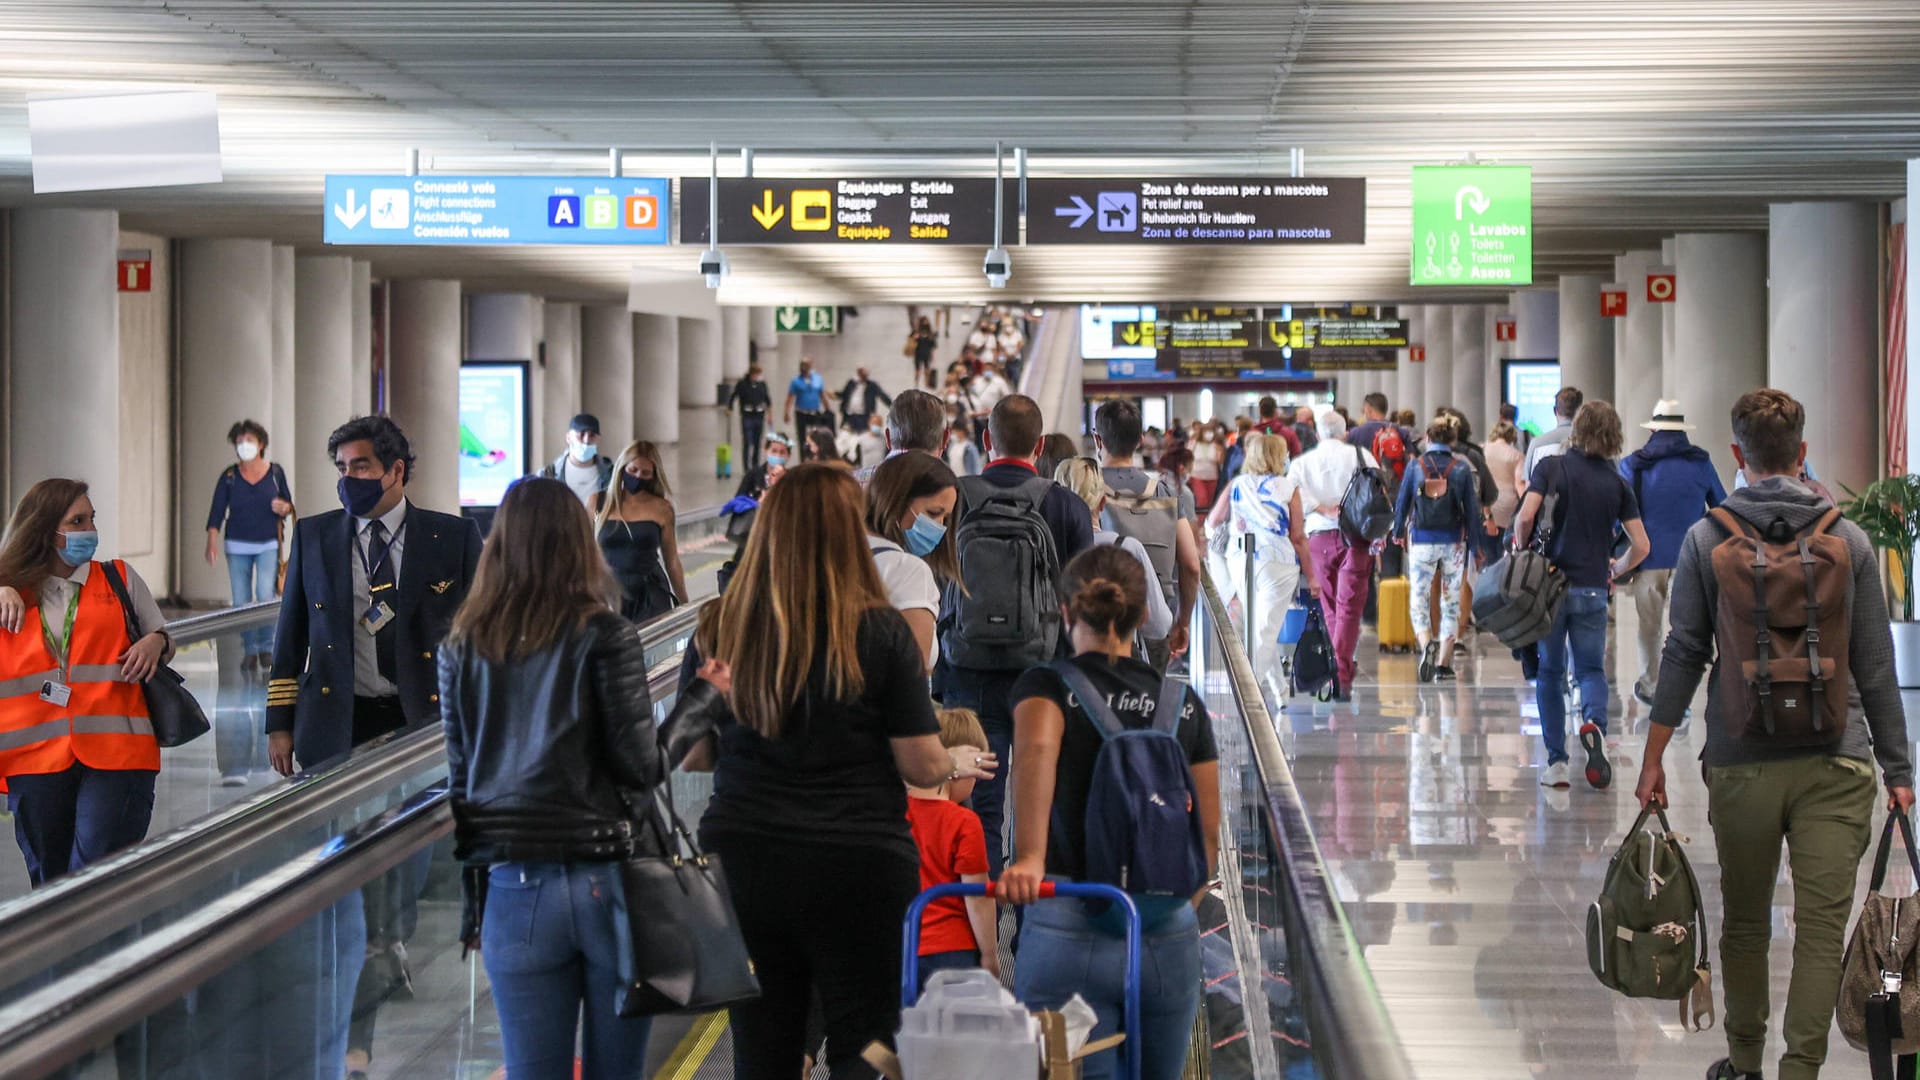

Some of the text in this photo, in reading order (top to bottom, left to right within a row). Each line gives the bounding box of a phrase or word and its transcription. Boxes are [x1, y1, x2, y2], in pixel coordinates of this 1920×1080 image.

[414, 181, 495, 194] Connexió vols
[837, 181, 904, 196] Equipatges
[910, 181, 954, 194] Sortida
[1142, 183, 1329, 198] Zona de descans per a mascotes
[414, 195, 496, 210] Flight connections
[837, 196, 877, 210] Baggage
[910, 197, 928, 209] Exit
[1142, 198, 1203, 210] Pet relief area
[414, 210, 483, 224] Anschlussflüge
[555, 199, 653, 225] A B D
[837, 210, 872, 224] Gepäck
[910, 211, 950, 225] Ausgang
[1142, 211, 1256, 224] Ruhebereich für Haustiere
[414, 225, 510, 238] Conexión vuelos
[837, 224, 891, 239] Equipaje
[910, 225, 948, 238] Salida
[1142, 226, 1332, 240] Zona de descanso para mascotas
[1469, 223, 1526, 236] Lavabos
[1471, 238, 1505, 250] Toilets
[1471, 252, 1515, 264] Toiletten
[1470, 265, 1512, 279] Aseos
[1117, 690, 1155, 718] help
